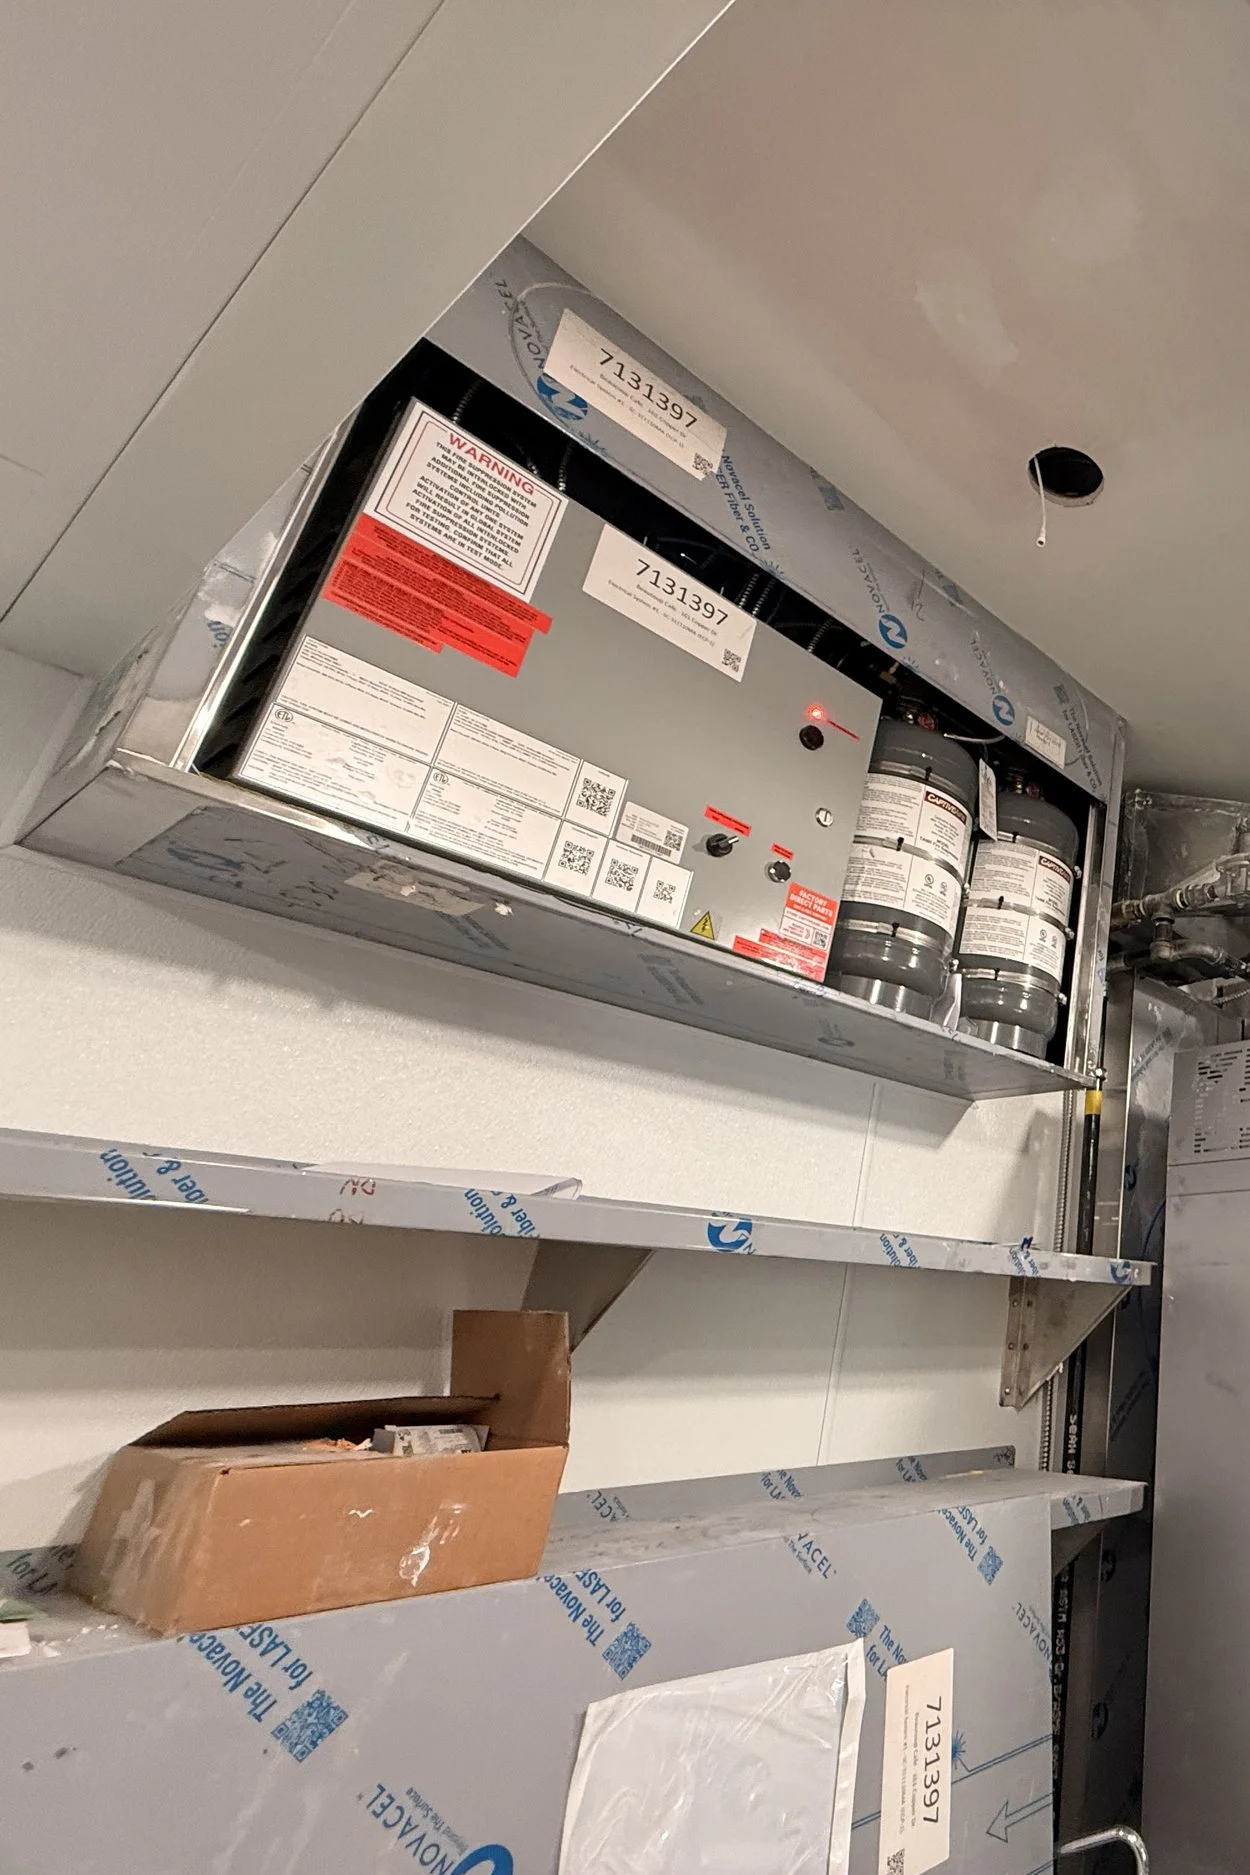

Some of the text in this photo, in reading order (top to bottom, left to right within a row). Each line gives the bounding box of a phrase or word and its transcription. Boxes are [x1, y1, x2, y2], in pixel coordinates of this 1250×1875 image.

[599, 348, 698, 428] 7131397
[431, 456, 529, 519] ADDITIONAL FIRE SUPPRESSION
[436, 442, 536, 508] THIS FIRE SUPPRESSION SYSTEM
[441, 454, 526, 509] MAY BE INTERLOCKED WITH
[448, 433, 535, 495] WARNING
[414, 499, 430, 512] FIRE
[431, 509, 477, 538] SUPPRESSION
[416, 482, 521, 546] WILL RESULT IN GLOBAL SYSTEM
[419, 475, 523, 539] ACTIVATION OF ANY ONE SYSTEM
[426, 462, 528, 527] SYSTEMS INCLUDING POLLUTION
[449, 484, 478, 505] CONTROL
[722, 455, 771, 550] Novacel Solution
[724, 492, 744, 522] Fiber
[740, 524, 750, 533] &
[405, 503, 420, 515] FOR
[452, 529, 483, 550] CONFIRM
[484, 546, 501, 559] THAT
[501, 556, 513, 566] ALL
[409, 514, 442, 536] SYSTEMS
[442, 532, 457, 544] ARE
[457, 540, 465, 548] IN
[466, 544, 482, 558] TEST
[411, 489, 519, 553] ACTIVATION OF ALL INTERLOCKED
[634, 558, 727, 628] 7131397
[852, 548, 885, 613] NOVACEL
[788, 892, 813, 909] DIRECT
[811, 902, 834, 917] PARTS
[798, 889, 828, 907] FACTORY
[100, 1149, 156, 1201] lution
[156, 1160, 208, 1203] & ber
[464, 1189, 502, 1236] olution
[500, 1193, 536, 1236] & iber
[879, 1233, 901, 1267] olution
[899, 1237, 919, 1266] & iber
[591, 1490, 617, 1523] ACEL
[769, 1486, 786, 1500] LA
[942, 1508, 978, 1562] Novace The
[957, 1505, 988, 1545] LASE for
[575, 1569, 626, 1623] LASE for
[582, 1614, 605, 1647] The
[880, 1625, 895, 1651] The
[239, 1623, 313, 1691] LASE for
[866, 1644, 880, 1667] for
[243, 1681, 278, 1723] The
[922, 1695, 941, 1827] 7131397
[406, 1787, 434, 1819] Surface
[366, 1783, 455, 1875] NOVACEL
